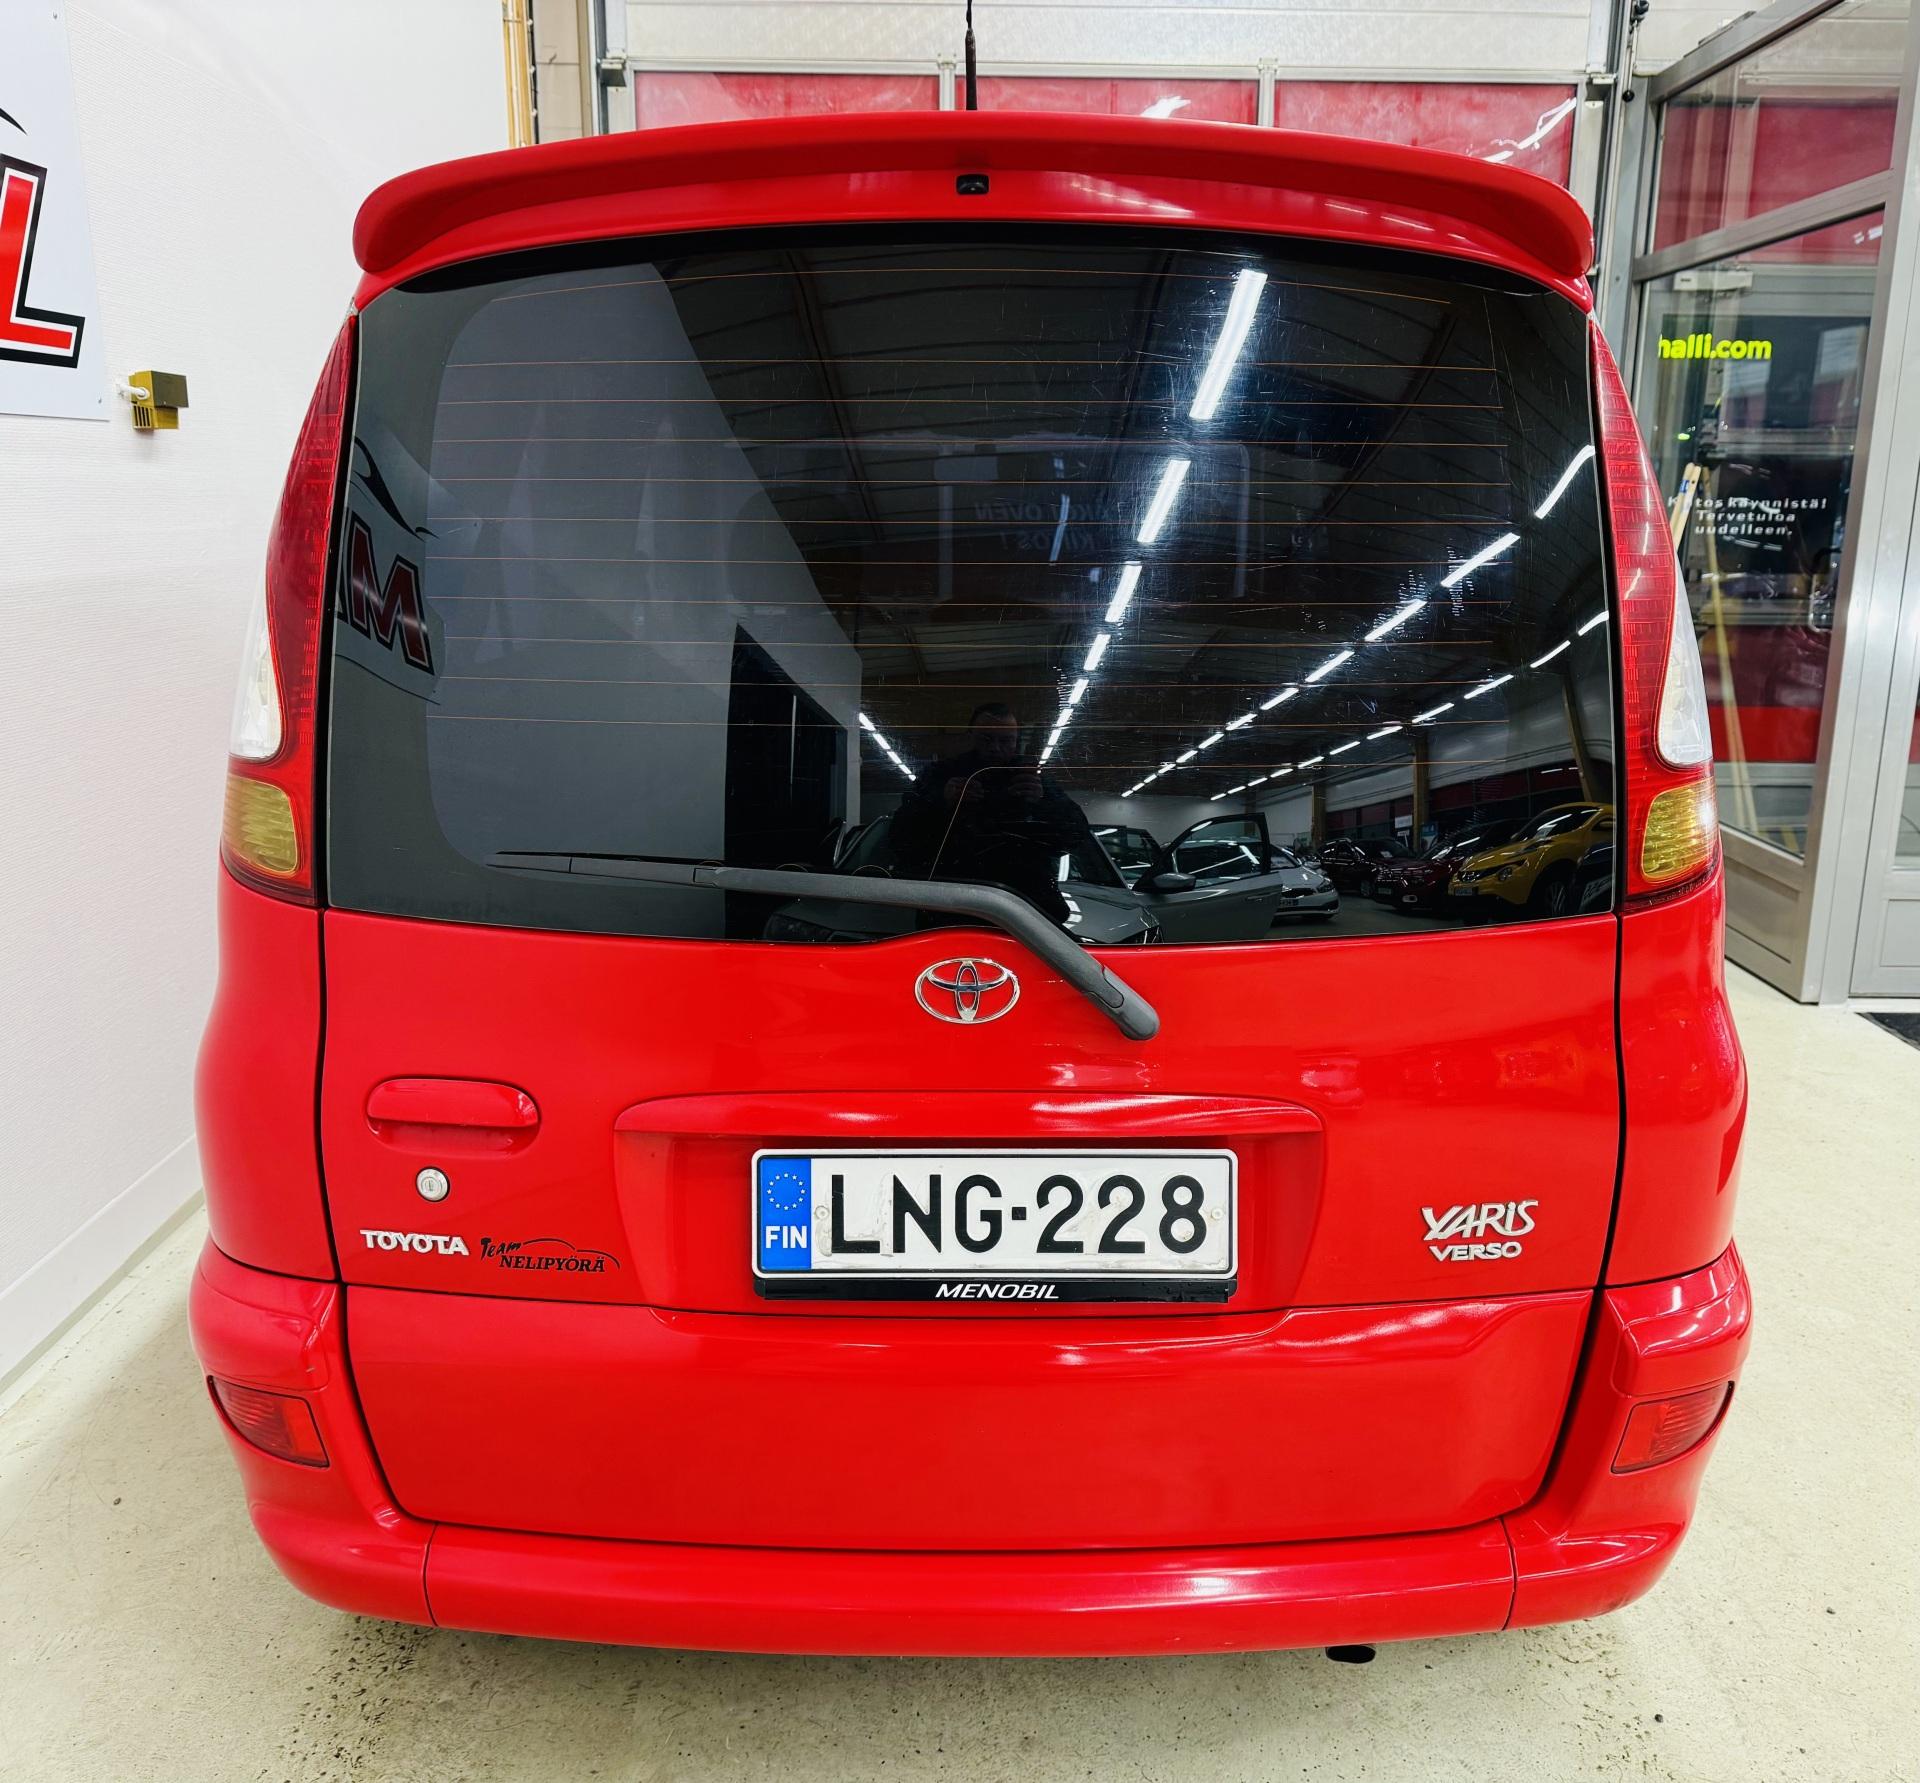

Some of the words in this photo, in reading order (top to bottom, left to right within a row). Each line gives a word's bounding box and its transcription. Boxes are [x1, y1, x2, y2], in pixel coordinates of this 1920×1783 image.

[1667, 496, 1723, 509] Ktos
[1695, 509, 1794, 522] Tervetuloa
[1694, 522, 1792, 535] uudelleen.
[831, 1173, 1208, 1254] LNG-228
[1422, 1199, 1539, 1241] YARIS
[359, 1229, 470, 1256] TOYOTA
[765, 1225, 808, 1249] FIN
[480, 1237, 522, 1260] Team
[1429, 1241, 1522, 1262] VERSO
[498, 1254, 605, 1273] NELIPYÖRÄ
[935, 1283, 1060, 1300] MENOBIL
